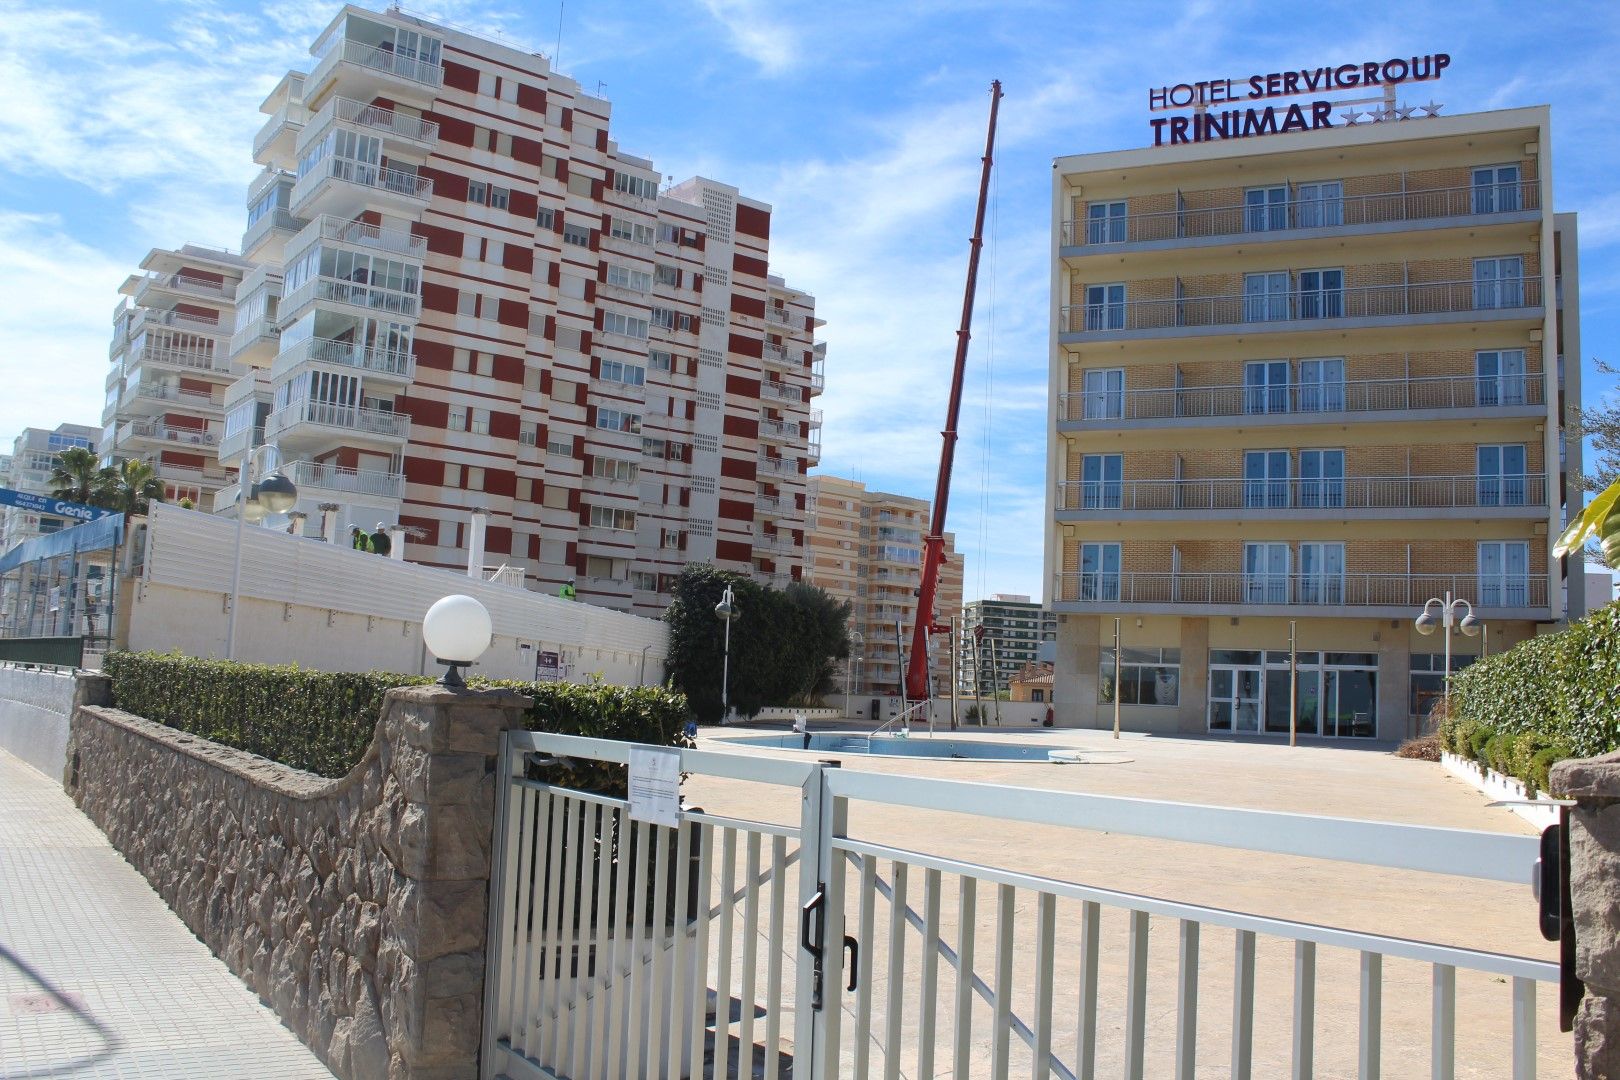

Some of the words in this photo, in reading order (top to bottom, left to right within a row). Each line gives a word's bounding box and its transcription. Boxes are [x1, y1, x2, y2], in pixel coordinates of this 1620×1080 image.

[1150, 78, 1239, 111] HOTEL
[1248, 54, 1450, 99] SERVIGROUP
[1150, 100, 1334, 146] TRINIMAR
[55, 502, 92, 519] Genie
